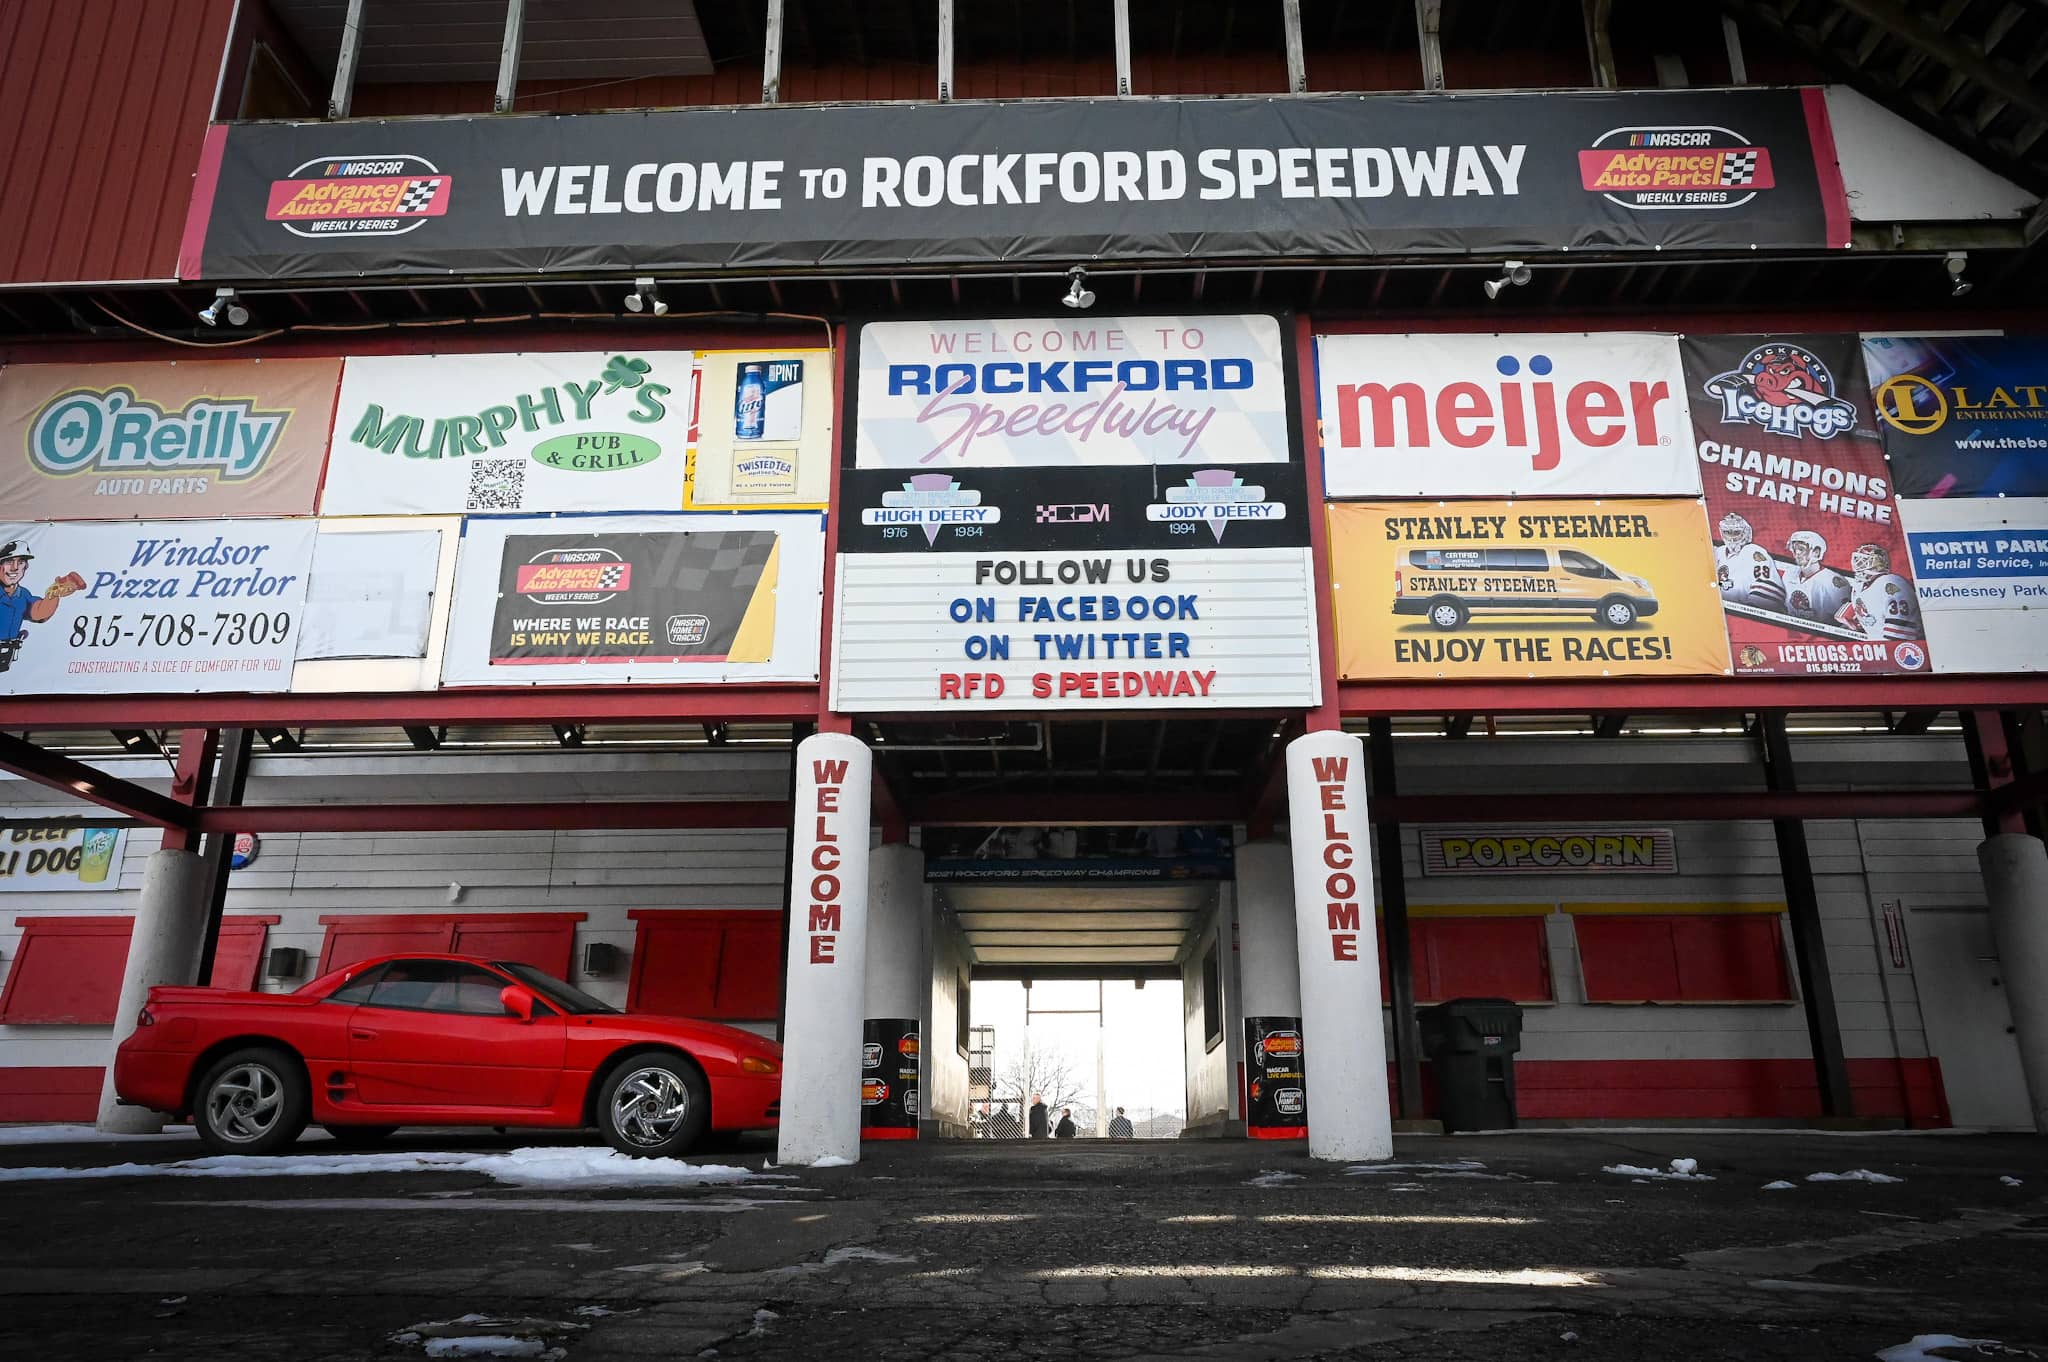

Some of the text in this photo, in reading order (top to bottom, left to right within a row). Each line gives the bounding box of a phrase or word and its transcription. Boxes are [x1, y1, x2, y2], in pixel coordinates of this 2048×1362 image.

[1650, 133, 1711, 146] NASCAR
[344, 161, 404, 176] NASCAR
[1605, 152, 1715, 172] Advance
[501, 145, 1527, 216] WELCOME TO ROCKFORD SPEEDWAY
[1594, 171, 1712, 187] Auto Parts
[293, 182, 401, 202] Advance
[1636, 192, 1728, 204] WEEKLY SERIES
[277, 199, 392, 217] Auto Parts
[311, 219, 399, 232] WEEKLY SERIES
[930, 328, 1206, 354] WELCOME TO
[776, 364, 799, 382] PINT
[1746, 347, 1828, 384] ROCKFORD
[888, 358, 1254, 397] ROCKFORD
[916, 375, 1217, 464] Speedway
[1337, 354, 1670, 471] meijer
[1720, 387, 1851, 435] IceHogs
[1956, 410, 2048, 420] ENTERTAINME
[37, 392, 280, 473] O'Reilly
[576, 435, 622, 451] PUB
[546, 450, 645, 469] & GRILL
[736, 460, 775, 473] TWISTED
[775, 460, 792, 473] TEA
[1699, 440, 1888, 500] CHAMPIONS
[95, 477, 208, 496] AUTO PARTS
[1725, 472, 1893, 525] START HERE
[874, 509, 988, 523] HUGH DEERY
[1160, 505, 1273, 518] JODY DEERY
[882, 526, 984, 538] 1976 1984
[1169, 523, 1195, 534] 1994
[1385, 515, 1652, 541] STANLEY STEEMER
[129, 536, 270, 567] Windsor
[1919, 540, 2048, 555] NORTH PARK
[562, 552, 601, 562] NASCAR
[1925, 557, 2048, 570] Rental Service, In
[533, 567, 598, 580] Advance
[975, 558, 1170, 585] FOLLOW US
[85, 568, 297, 600] Pizza Parlor
[523, 578, 596, 590] Auto Parts
[1410, 577, 1557, 593] STANLEY STEEMER
[1919, 584, 2048, 599] Machesney Park
[545, 592, 600, 601] WEEKLY SERIES
[950, 594, 1199, 623] ON FACEBOOK
[1888, 600, 1909, 615] 33
[69, 611, 291, 648] 815-708-7309
[512, 617, 649, 631] WHERE WE RACE
[670, 626, 692, 635] HOME
[674, 618, 706, 627] NASCAR
[511, 631, 653, 646] IS WHY WE RACE.
[672, 634, 702, 643] TRACKS
[964, 632, 1190, 660] ON TWITTER
[1394, 636, 1672, 663] ENJOY THE RACES!
[1778, 643, 1888, 663] ICEHOGS.COM
[68, 659, 281, 674] CONSTRUCTING A SLICE OF COMFORT FOR YOU
[940, 670, 1217, 699] RFD SPEEDWAY
[1311, 756, 1361, 961] WELCOME
[1441, 835, 1654, 867] POPCORN
[808, 759, 849, 964] WELCOME
[926, 868, 1160, 878] 2021 ROCKFORD SPEEDWAY CHAMPIONS
